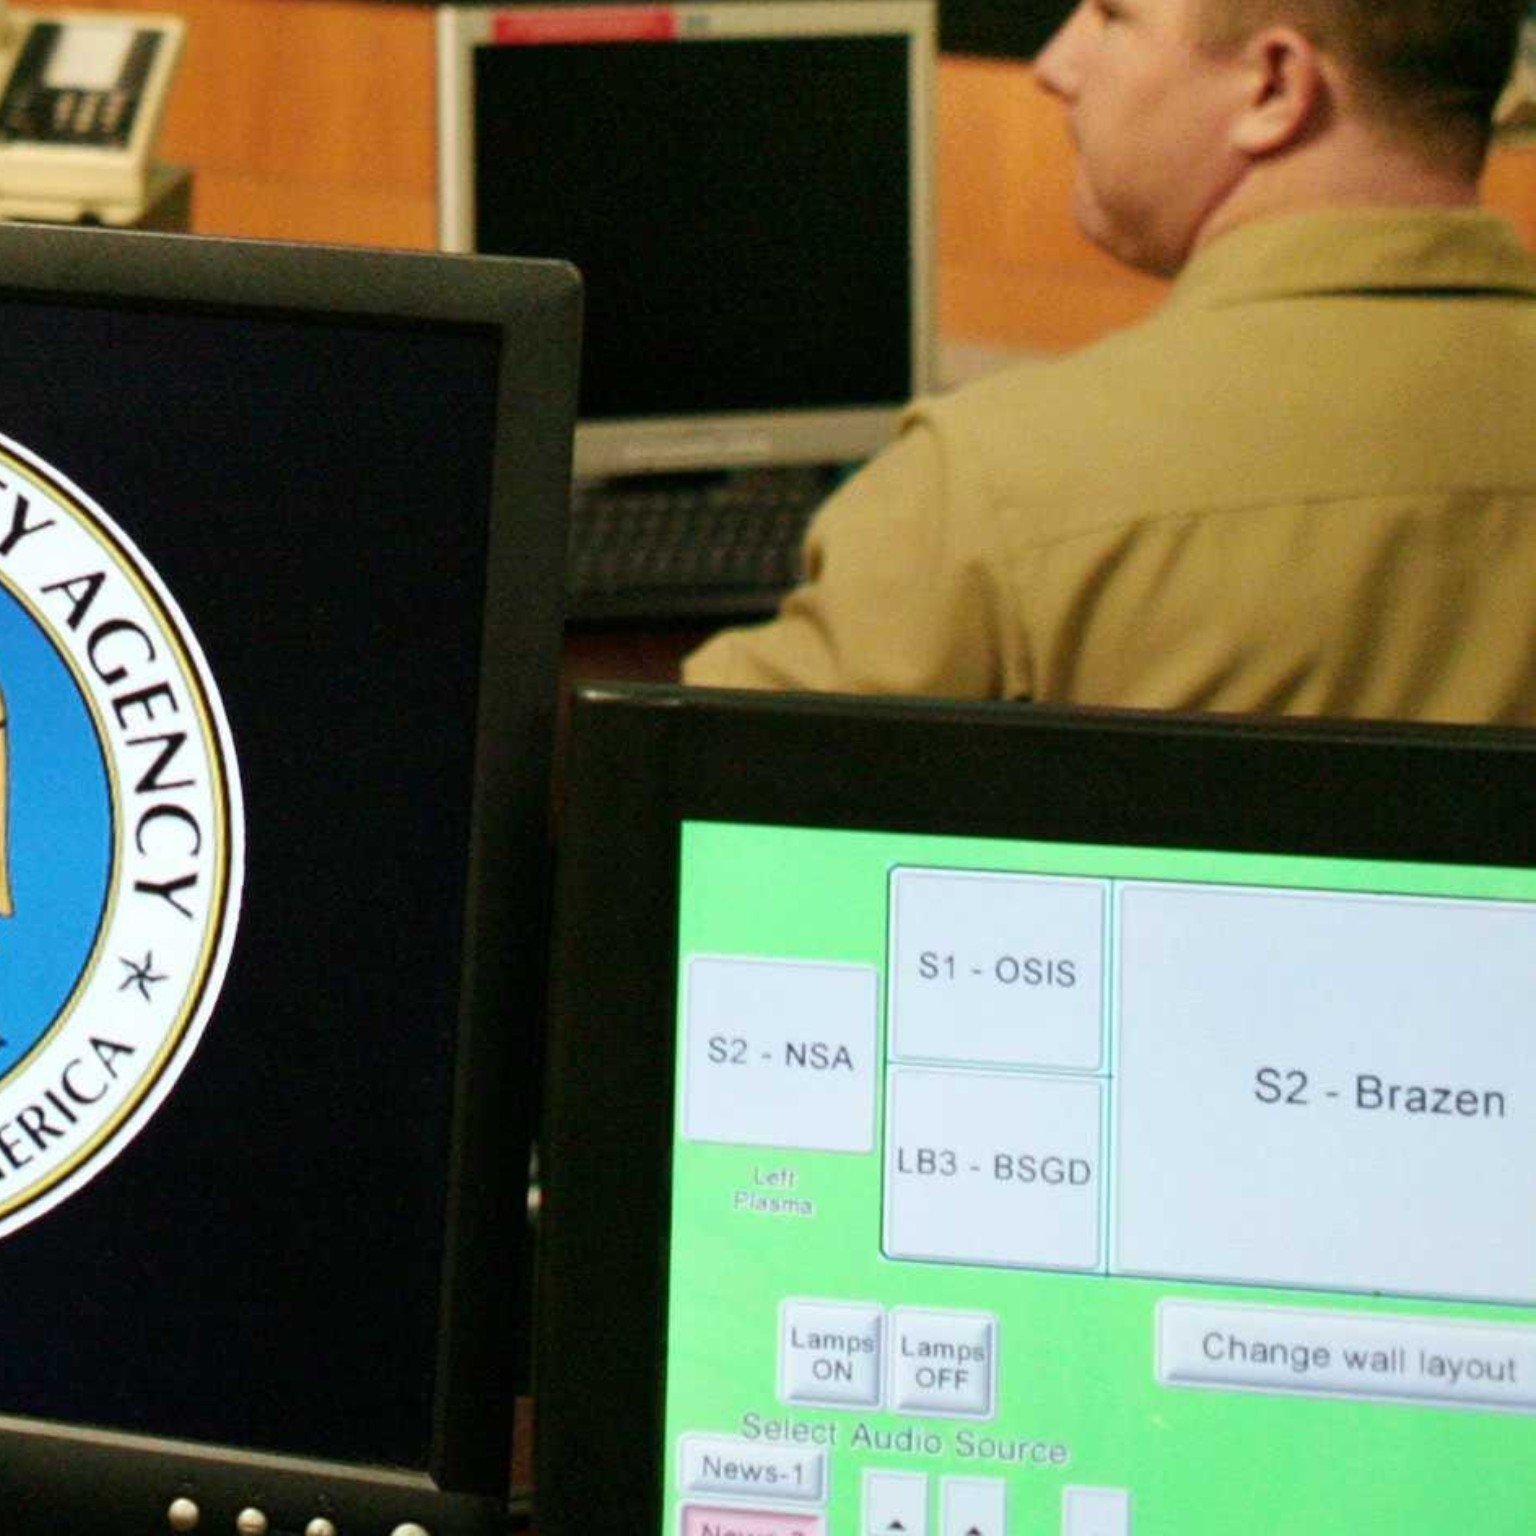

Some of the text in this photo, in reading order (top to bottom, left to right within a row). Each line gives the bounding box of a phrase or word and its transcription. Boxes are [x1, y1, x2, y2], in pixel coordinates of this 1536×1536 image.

[41, 571, 201, 919] AGENCY
[919, 951, 955, 980] S1
[995, 956, 1078, 989] OSIS
[706, 1035, 748, 1065] S2
[785, 1041, 855, 1072] NSA
[1254, 1066, 1309, 1105] S2
[1355, 1073, 1506, 1119] Brazen
[752, 1166, 796, 1190] Left
[896, 1146, 959, 1178] LB3
[993, 1153, 1092, 1187] BSGD
[733, 1190, 814, 1216] Plasma
[790, 1326, 876, 1356] Lamps
[900, 1335, 986, 1366] Lamps
[1202, 1330, 1518, 1384] Change wall layout
[811, 1358, 854, 1383] ON
[915, 1366, 969, 1390] OFF
[742, 1413, 1068, 1466] Select Audio Source
[701, 1454, 805, 1486] News-1
